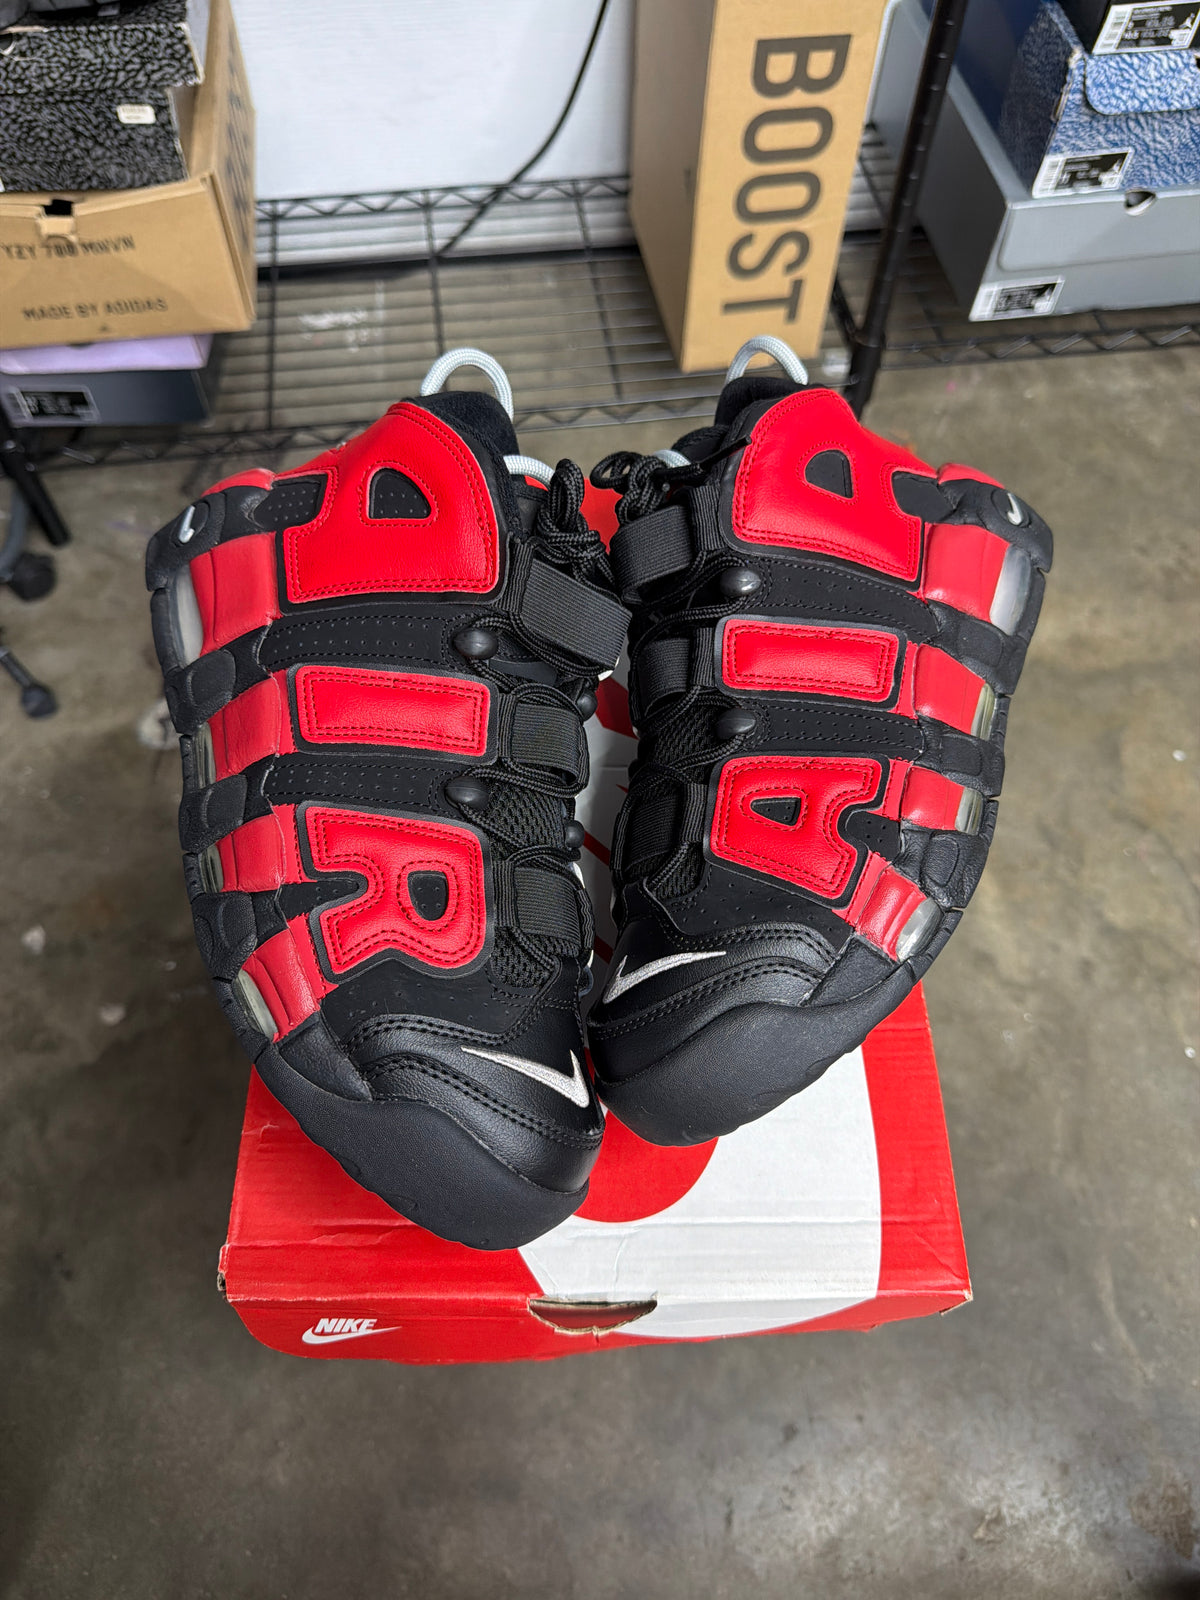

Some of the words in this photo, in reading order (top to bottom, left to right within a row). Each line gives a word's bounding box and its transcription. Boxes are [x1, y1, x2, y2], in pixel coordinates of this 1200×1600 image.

[721, 34, 852, 323] BOOST
[22, 303, 73, 321] MADE
[75, 302, 99, 318] BY
[104, 297, 169, 316] ADIDAS
[314, 1318, 377, 1333] NIKE
